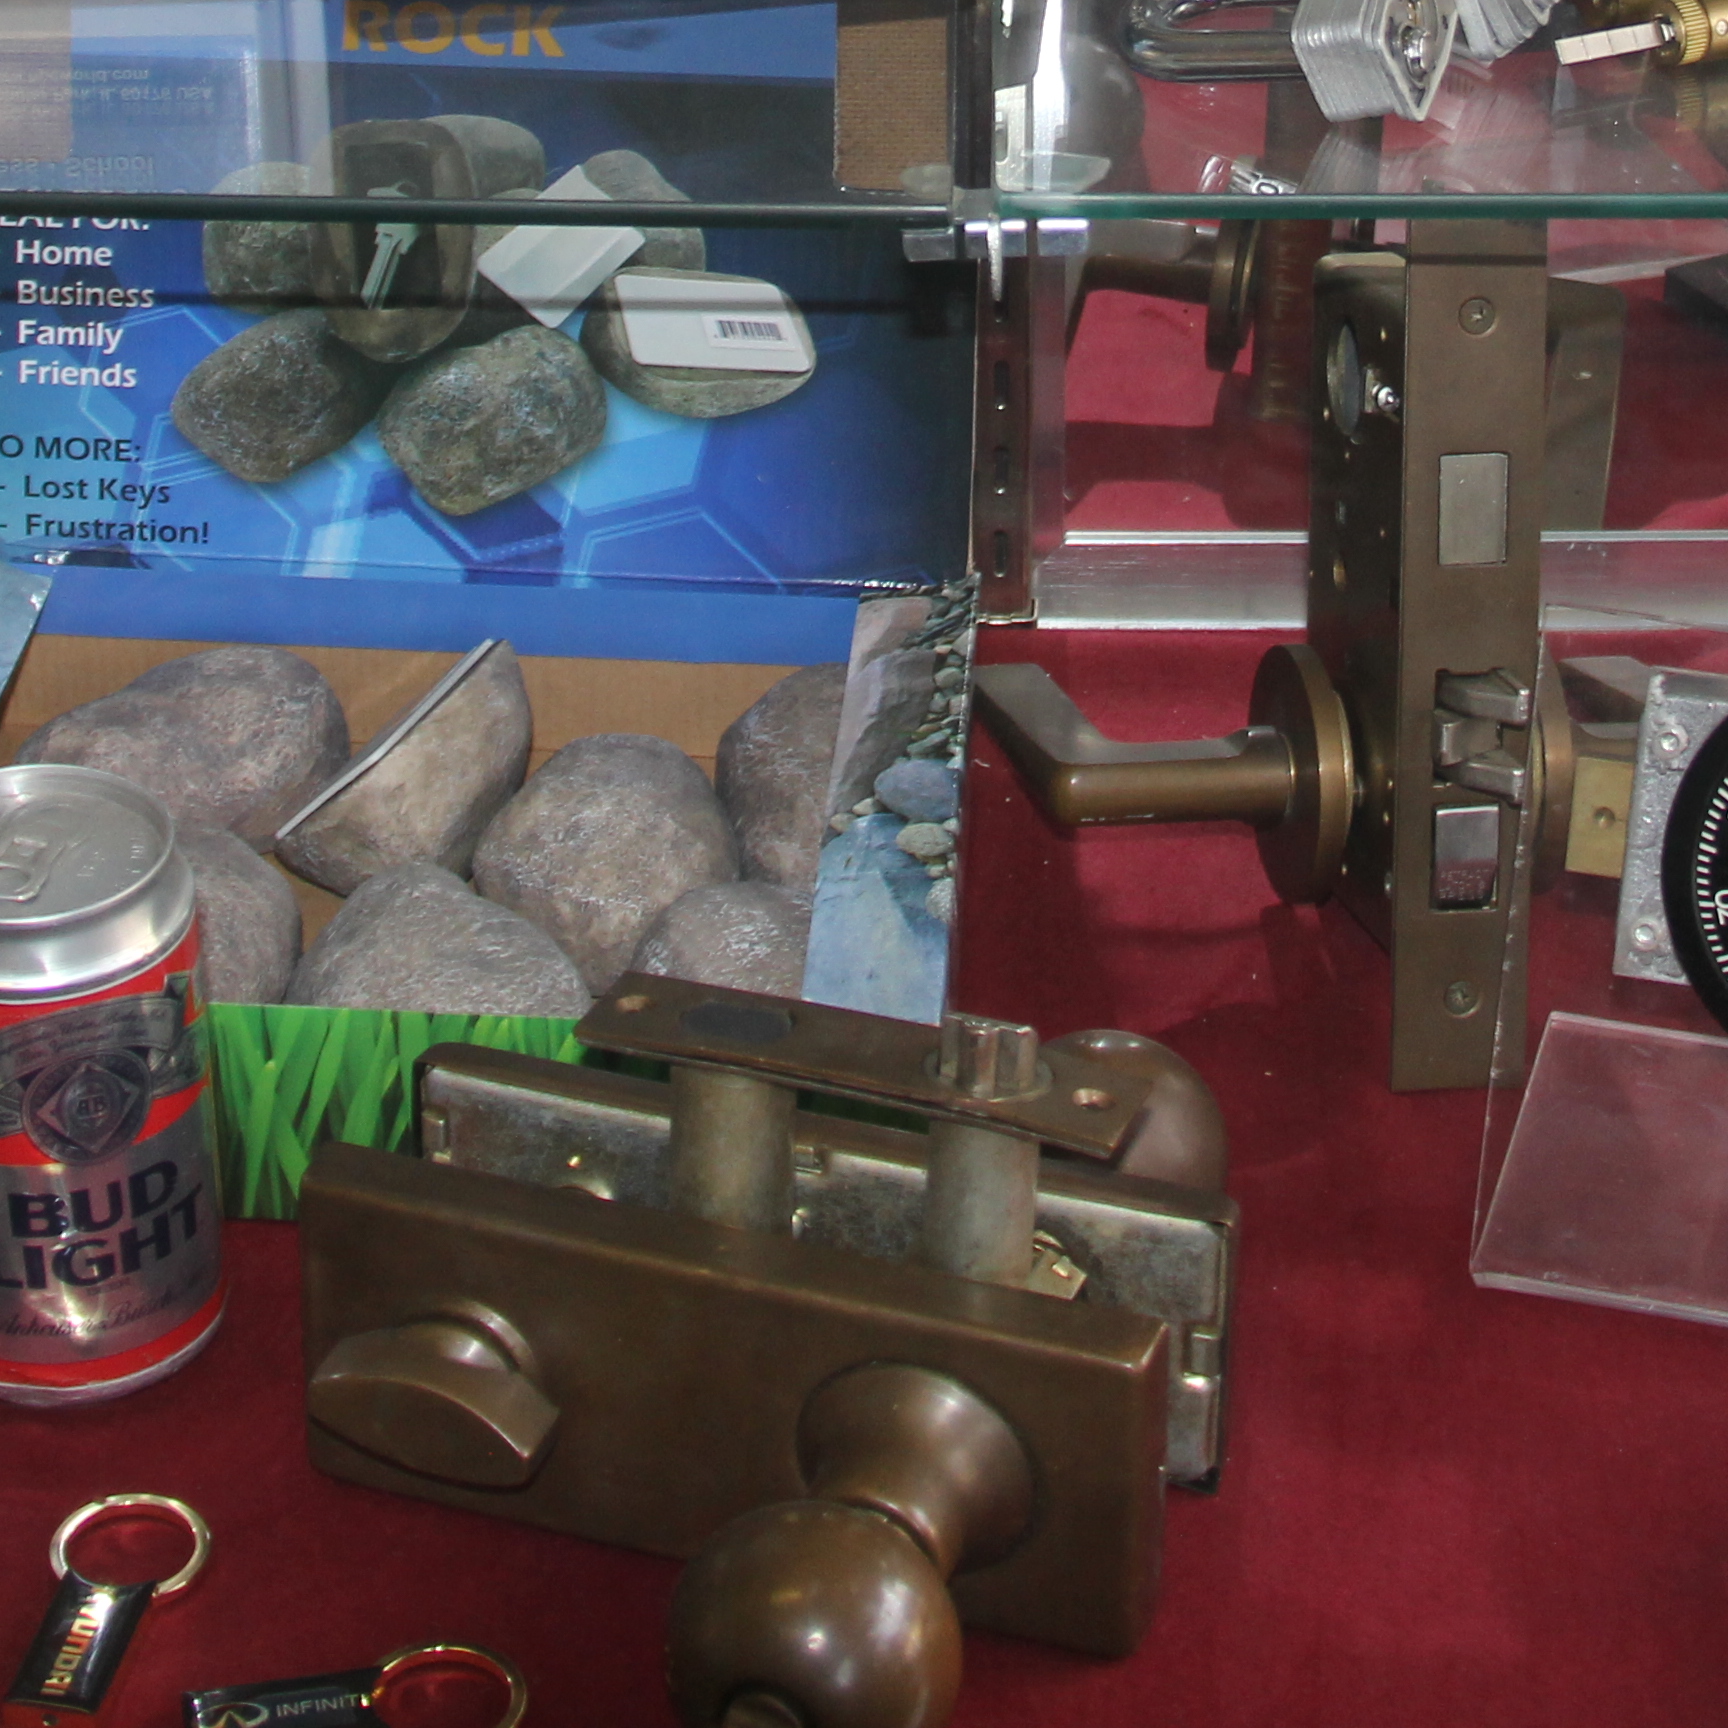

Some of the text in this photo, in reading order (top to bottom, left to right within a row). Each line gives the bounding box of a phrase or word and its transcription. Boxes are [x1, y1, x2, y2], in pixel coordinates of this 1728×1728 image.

[15, 240, 113, 267] Home
[16, 280, 155, 309] Business
[17, 320, 123, 352] Family
[18, 360, 137, 389] Friends
[35, 436, 141, 464] MORE:
[23, 475, 171, 508] Lost Keys
[24, 513, 210, 545] Frustration!
[8, 1160, 179, 1238] BUD
